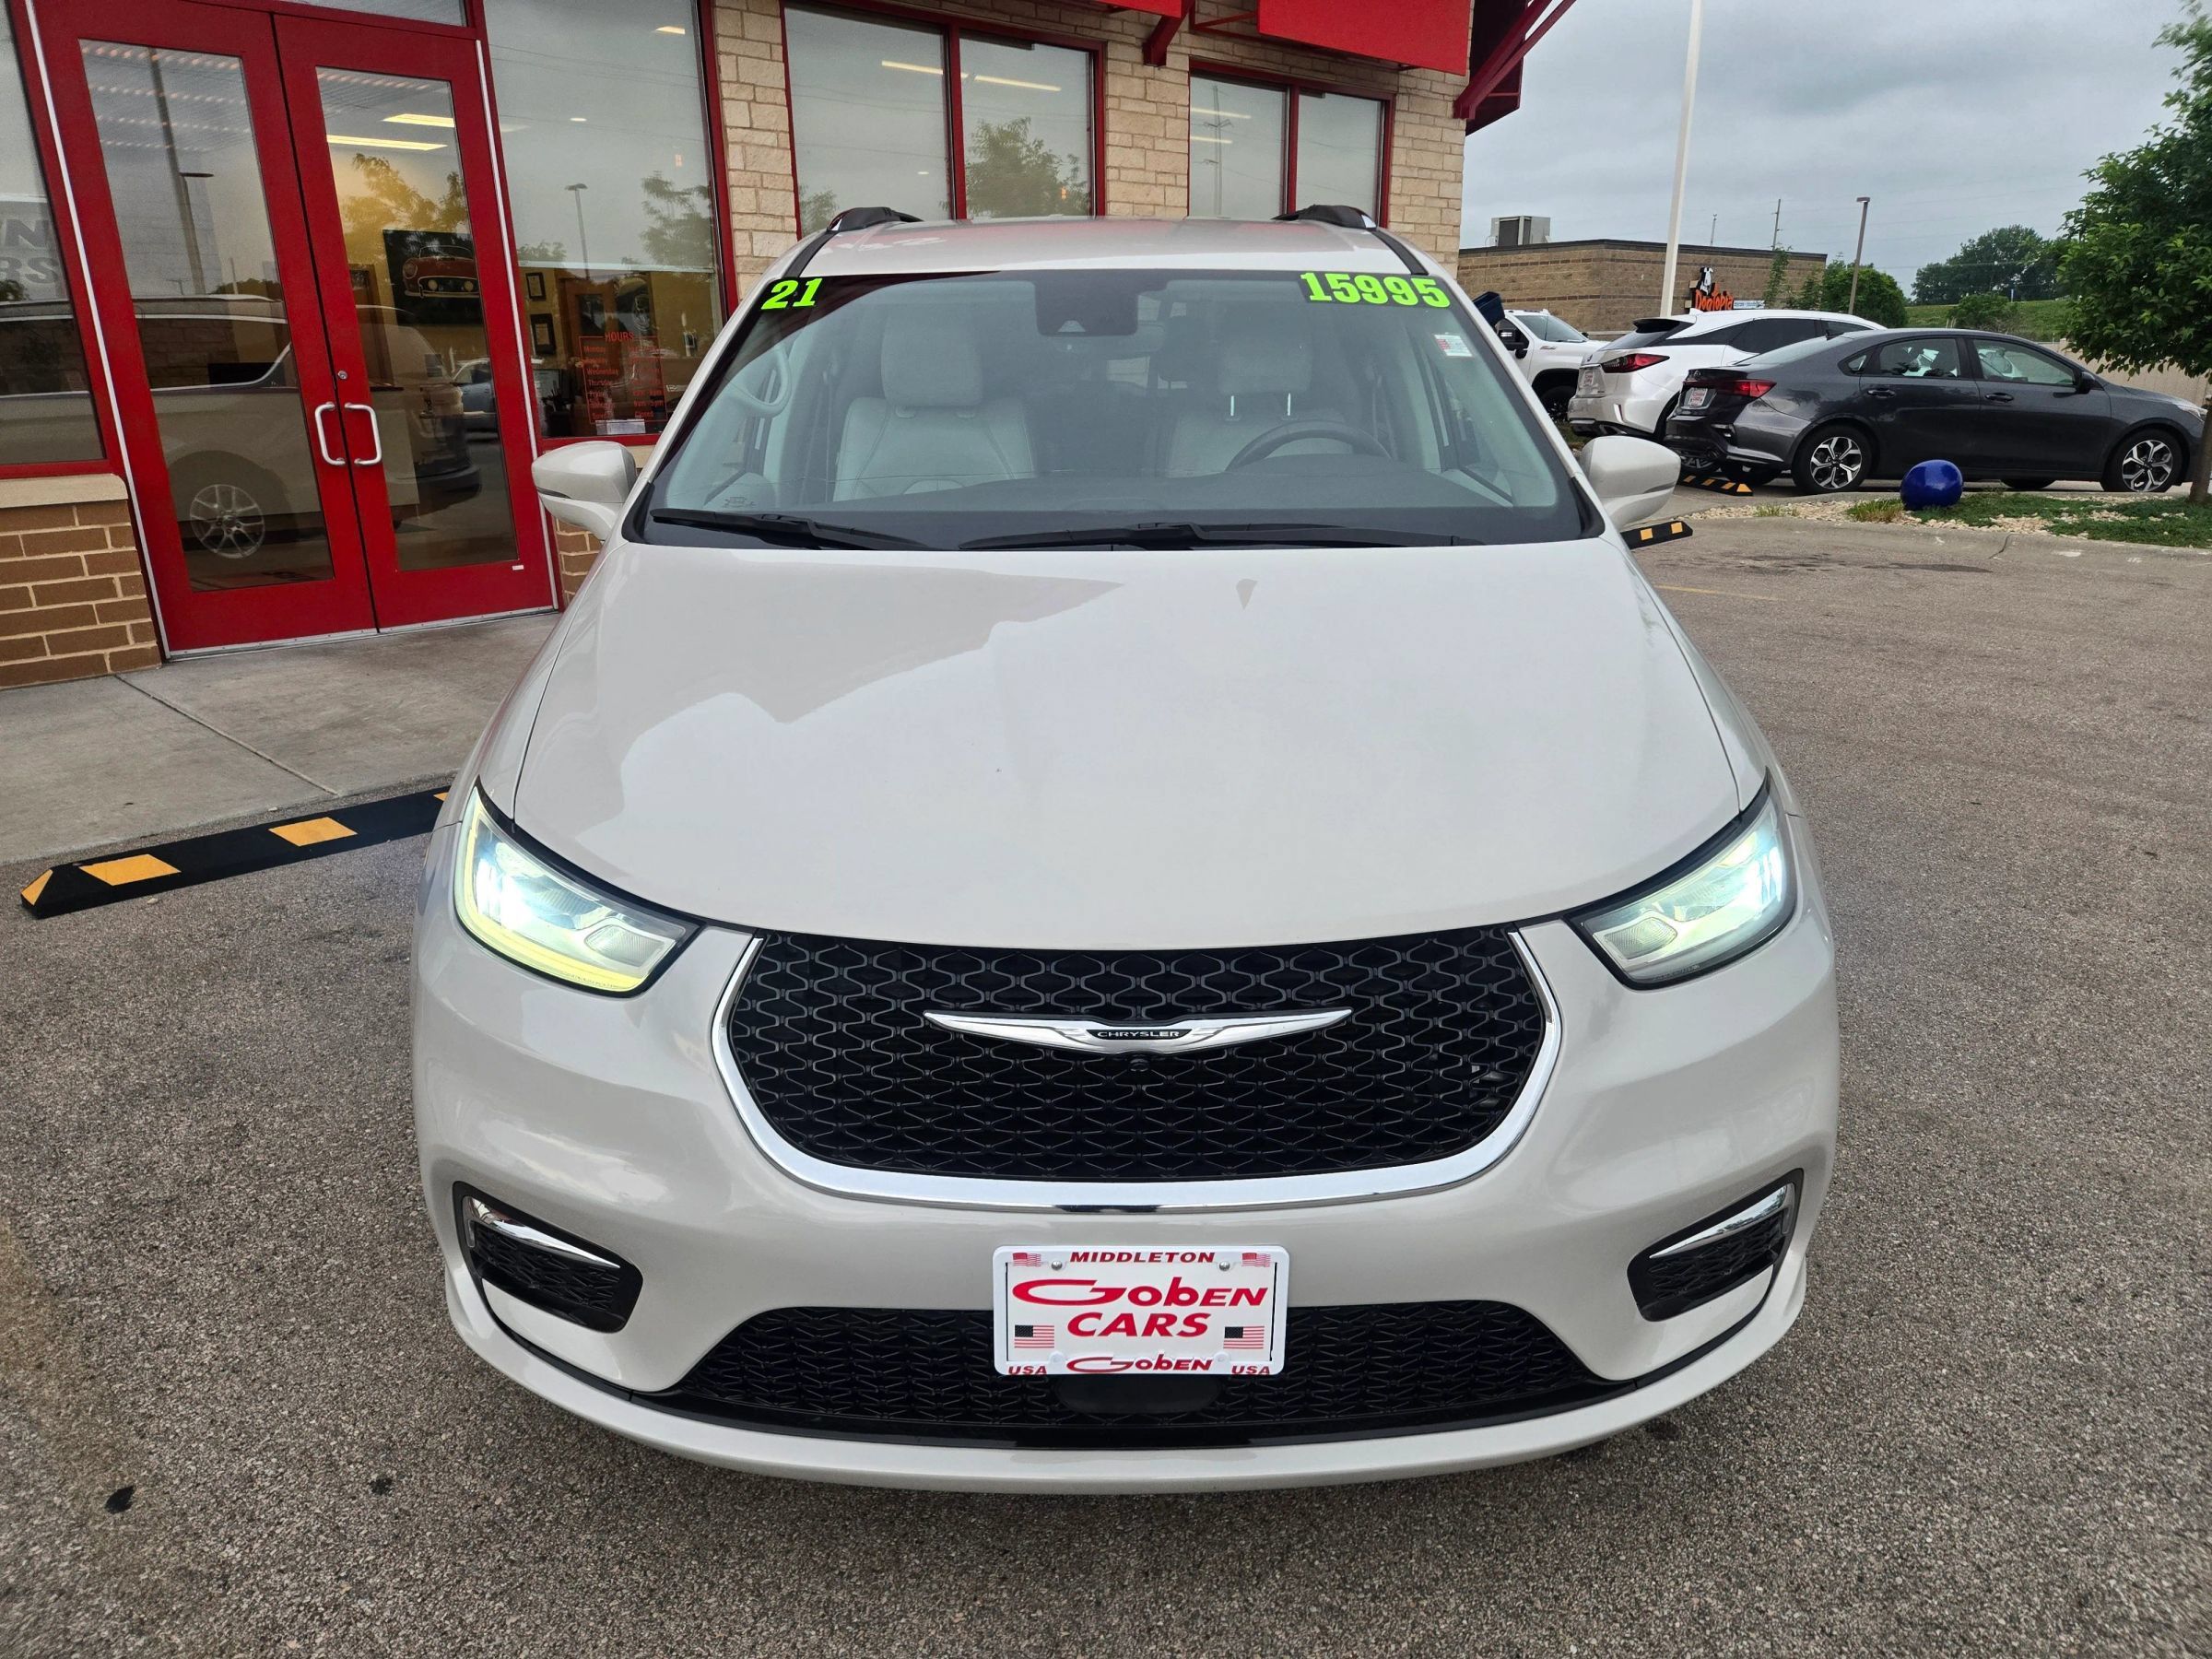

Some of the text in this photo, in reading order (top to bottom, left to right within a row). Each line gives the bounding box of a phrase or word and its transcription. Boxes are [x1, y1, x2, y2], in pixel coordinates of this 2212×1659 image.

[760, 277, 823, 310] 21
[1300, 272, 1451, 308] 15995
[605, 331, 634, 342] HOURS
[1069, 1252, 1215, 1264] MIDDLETON
[1066, 1312, 1212, 1337] CARS
[1008, 1365, 1048, 1376] USA
[1231, 1365, 1271, 1376] USA
